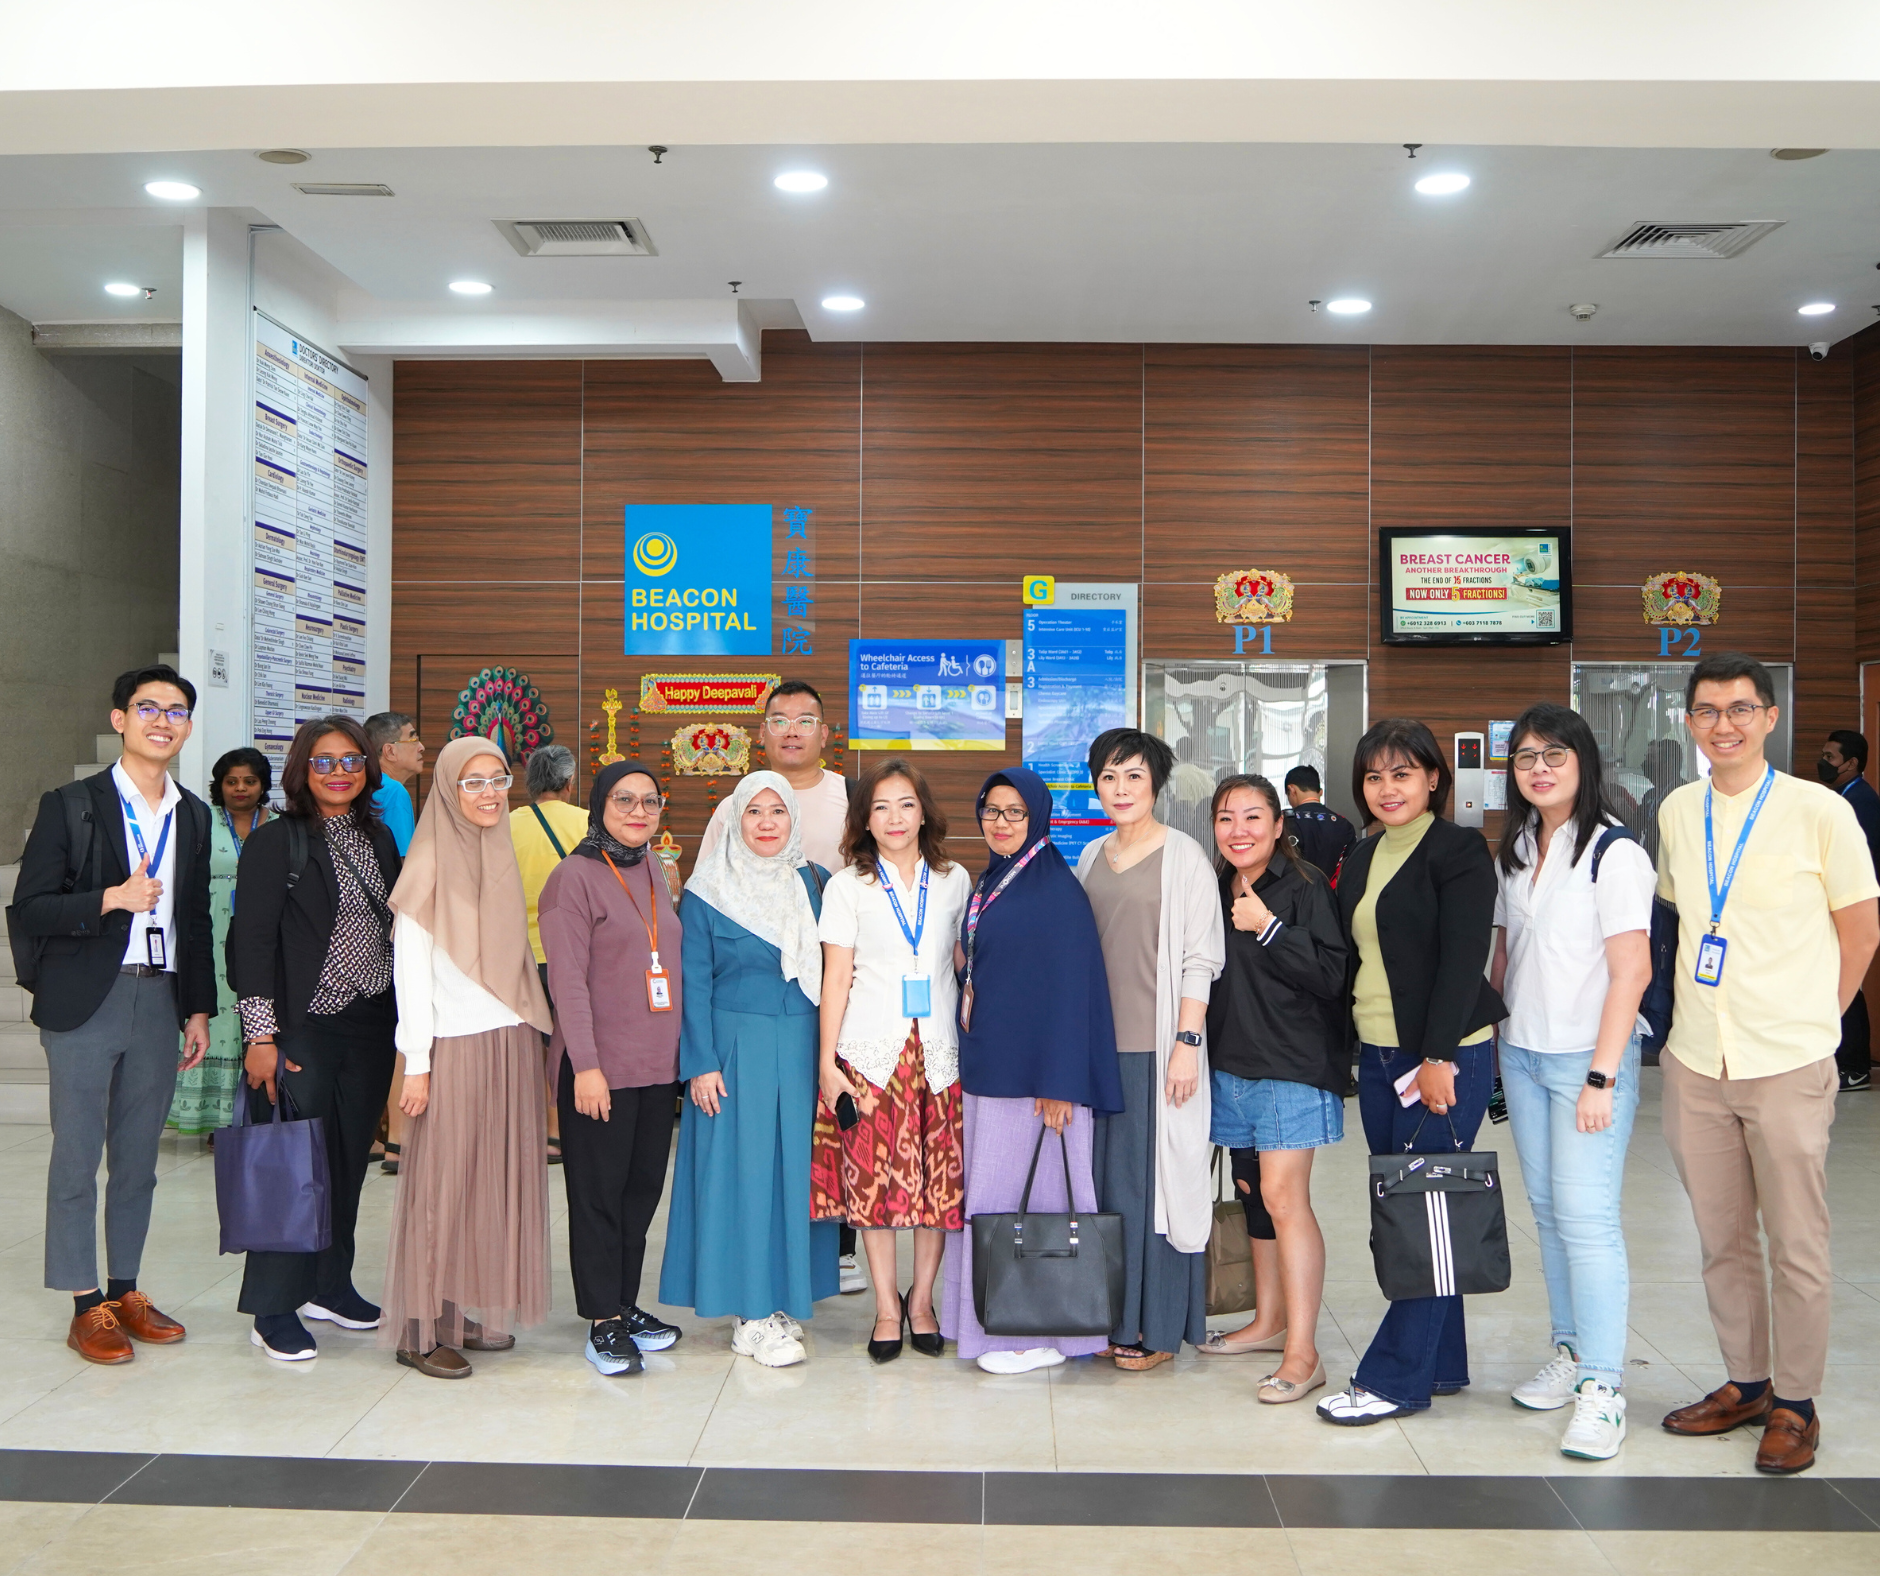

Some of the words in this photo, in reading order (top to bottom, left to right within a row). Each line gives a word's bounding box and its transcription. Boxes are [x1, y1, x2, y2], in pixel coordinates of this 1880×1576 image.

[319, 355, 338, 375] DIRECTORY
[315, 378, 327, 390] Medicine
[265, 413, 275, 424] Breast
[275, 418, 287, 431] Surgery
[267, 469, 283, 483] Cardiology
[351, 463, 363, 475] Surgery
[265, 532, 284, 546] Dermatology
[1400, 554, 1452, 565] BREAST
[1456, 554, 1511, 564] CANCER
[263, 577, 274, 587] General
[274, 580, 287, 592] Surgery
[782, 506, 814, 655] 寶康醫院
[350, 592, 360, 601] Medicine
[1029, 580, 1048, 600] G
[1410, 590, 1427, 598] NOW
[1430, 589, 1449, 598] ONLY
[1451, 586, 1460, 601] 5
[1463, 589, 1505, 598] FRACTIONS!
[632, 588, 737, 607] BEACON
[632, 612, 756, 631] HOSPITAL
[1028, 620, 1035, 631] 5
[349, 624, 358, 634] Surgery
[1232, 625, 1275, 654] P1
[1658, 628, 1701, 656] P2
[1027, 649, 1035, 660] 3
[871, 662, 908, 670] Cafeteria
[1027, 661, 1036, 672] A
[1027, 677, 1035, 688] 3
[665, 686, 700, 702] Happy
[702, 685, 757, 701] Deepavali
[1027, 741, 1034, 752] 2
[1749, 800, 1762, 820] BEACON
[1758, 778, 1772, 801] HOSPITAL
[1724, 866, 1736, 887] BEACON
[1732, 842, 1744, 867] HOSPITAL
